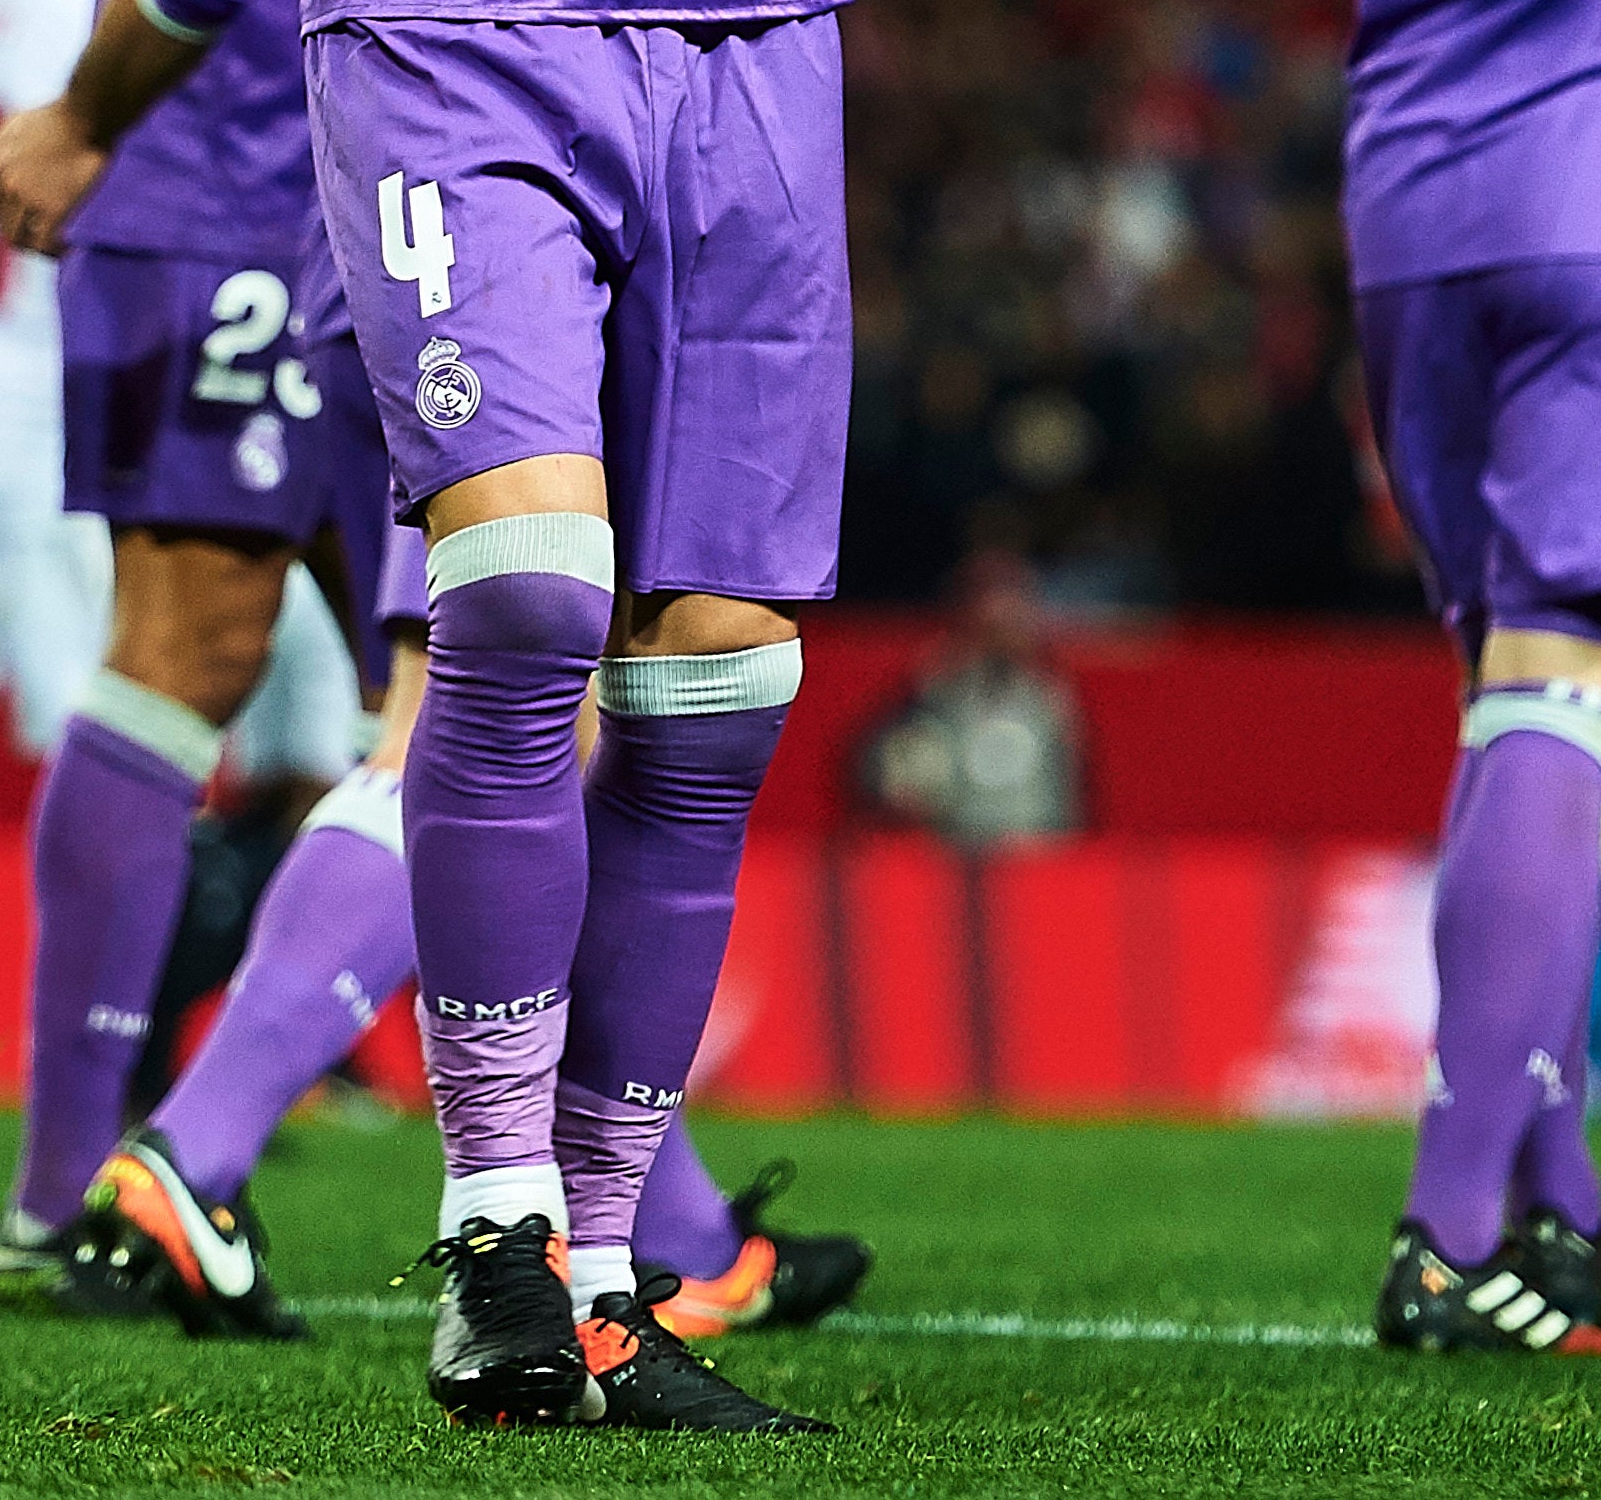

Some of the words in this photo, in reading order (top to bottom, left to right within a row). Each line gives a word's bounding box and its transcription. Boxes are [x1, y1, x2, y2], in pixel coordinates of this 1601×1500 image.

[378, 171, 455, 319] 4
[437, 987, 559, 1020] RMCF
[623, 1081, 684, 1107] RM
